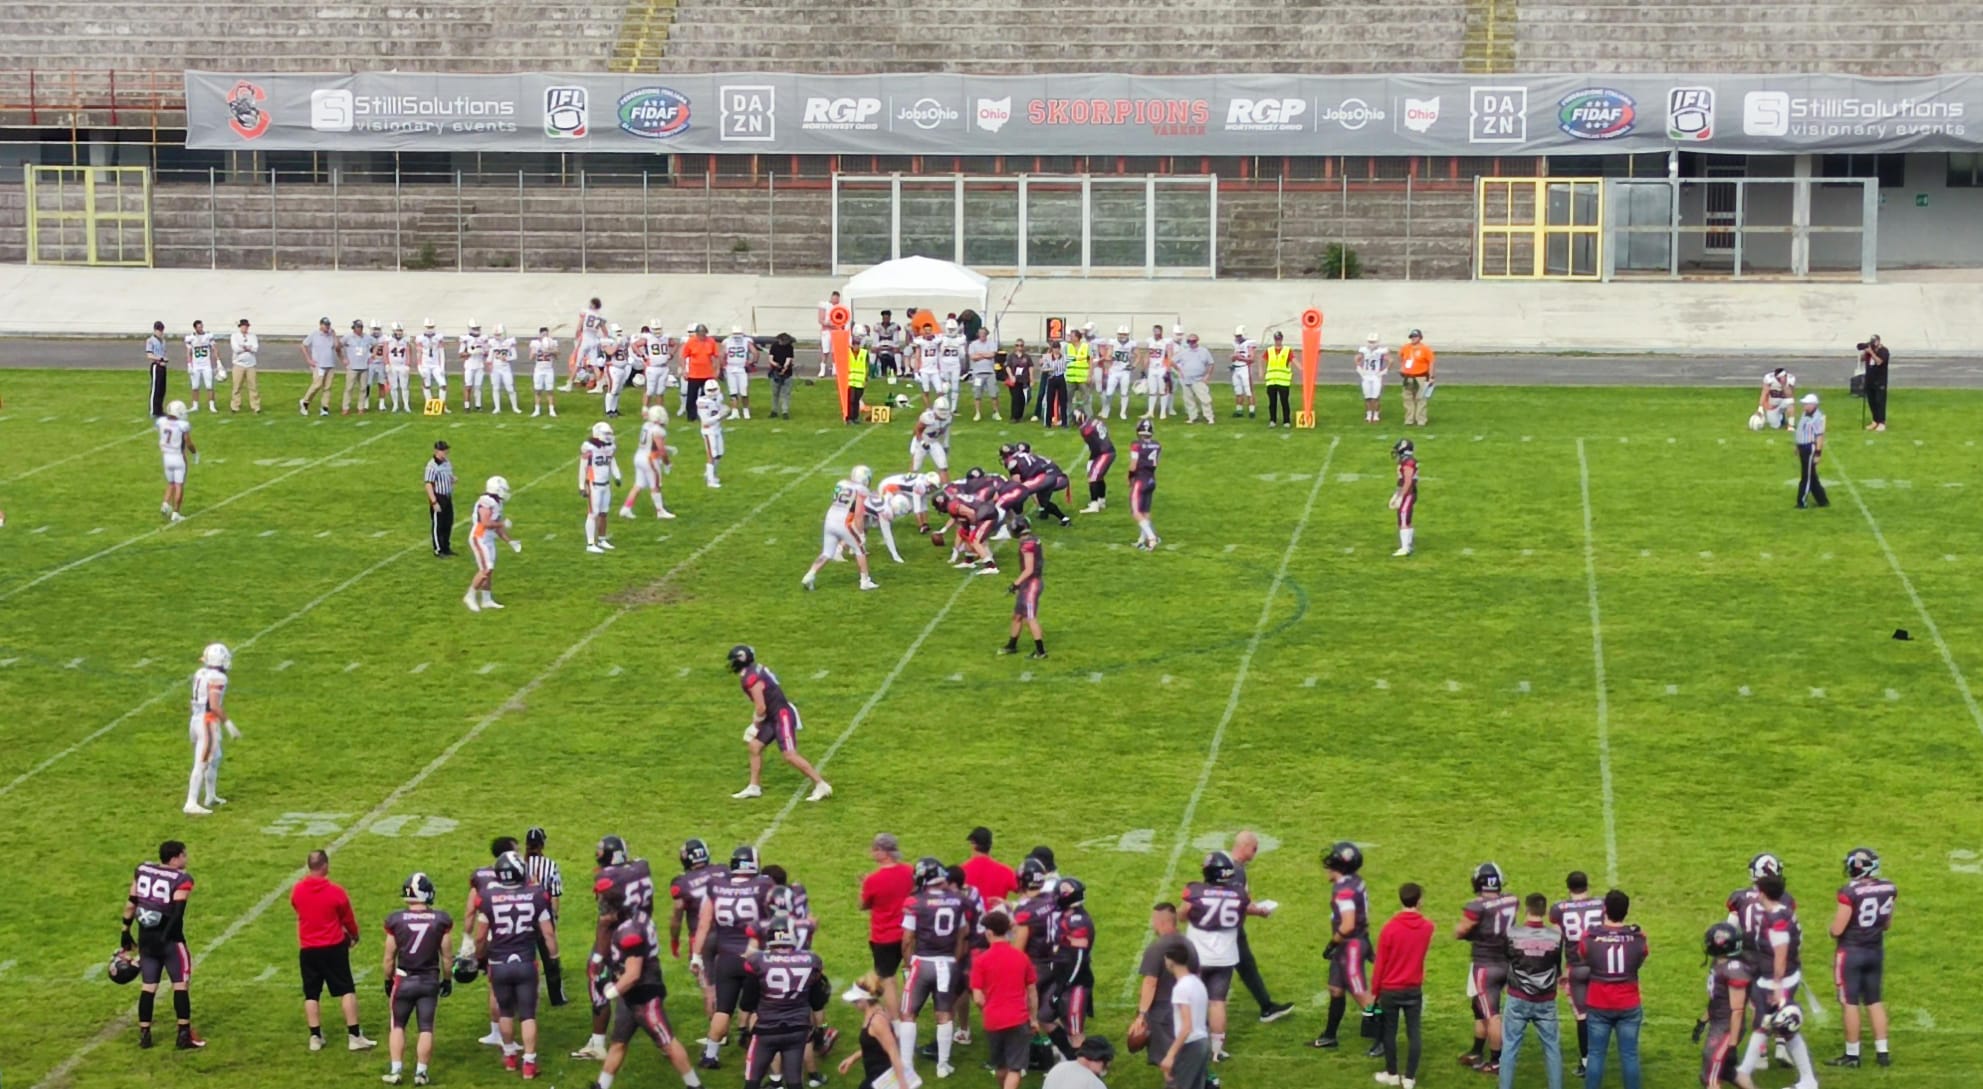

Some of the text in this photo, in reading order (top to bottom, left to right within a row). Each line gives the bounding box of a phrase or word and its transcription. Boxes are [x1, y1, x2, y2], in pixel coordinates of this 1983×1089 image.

[550, 90, 583, 110] IFL
[733, 94, 763, 112] DA
[1483, 95, 1514, 113] DA
[1673, 90, 1710, 110] IFL
[631, 106, 679, 120] FIDAF
[803, 97, 882, 123] RGP
[896, 107, 959, 120] JobsOhio
[980, 108, 1008, 120] Ohio
[1028, 98, 1209, 125] SKORPIONS
[1226, 98, 1306, 124] RGP
[1322, 107, 1386, 121] JobsOhio
[1407, 108, 1436, 120] Ohio
[1571, 107, 1623, 121] FIDAF
[355, 119, 518, 135] visionary events
[733, 115, 763, 132] ZN
[1483, 116, 1514, 134] ZN
[1791, 122, 1966, 138] visionary events
[586, 315, 607, 330] 87
[1050, 319, 1062, 338] 2
[426, 400, 441, 413] 40
[873, 409, 888, 422] 50
[163, 429, 172, 445] 7
[1148, 449, 1158, 467] 4
[136, 875, 170, 904] 99
[492, 902, 536, 935] 52
[1199, 897, 1241, 928] 76
[1494, 906, 1517, 936] 17
[1858, 896, 1894, 928] 84
[934, 907, 955, 937] 0
[408, 922, 431, 954] 7
[1607, 944, 1625, 974] 11
[766, 967, 813, 999] 97
